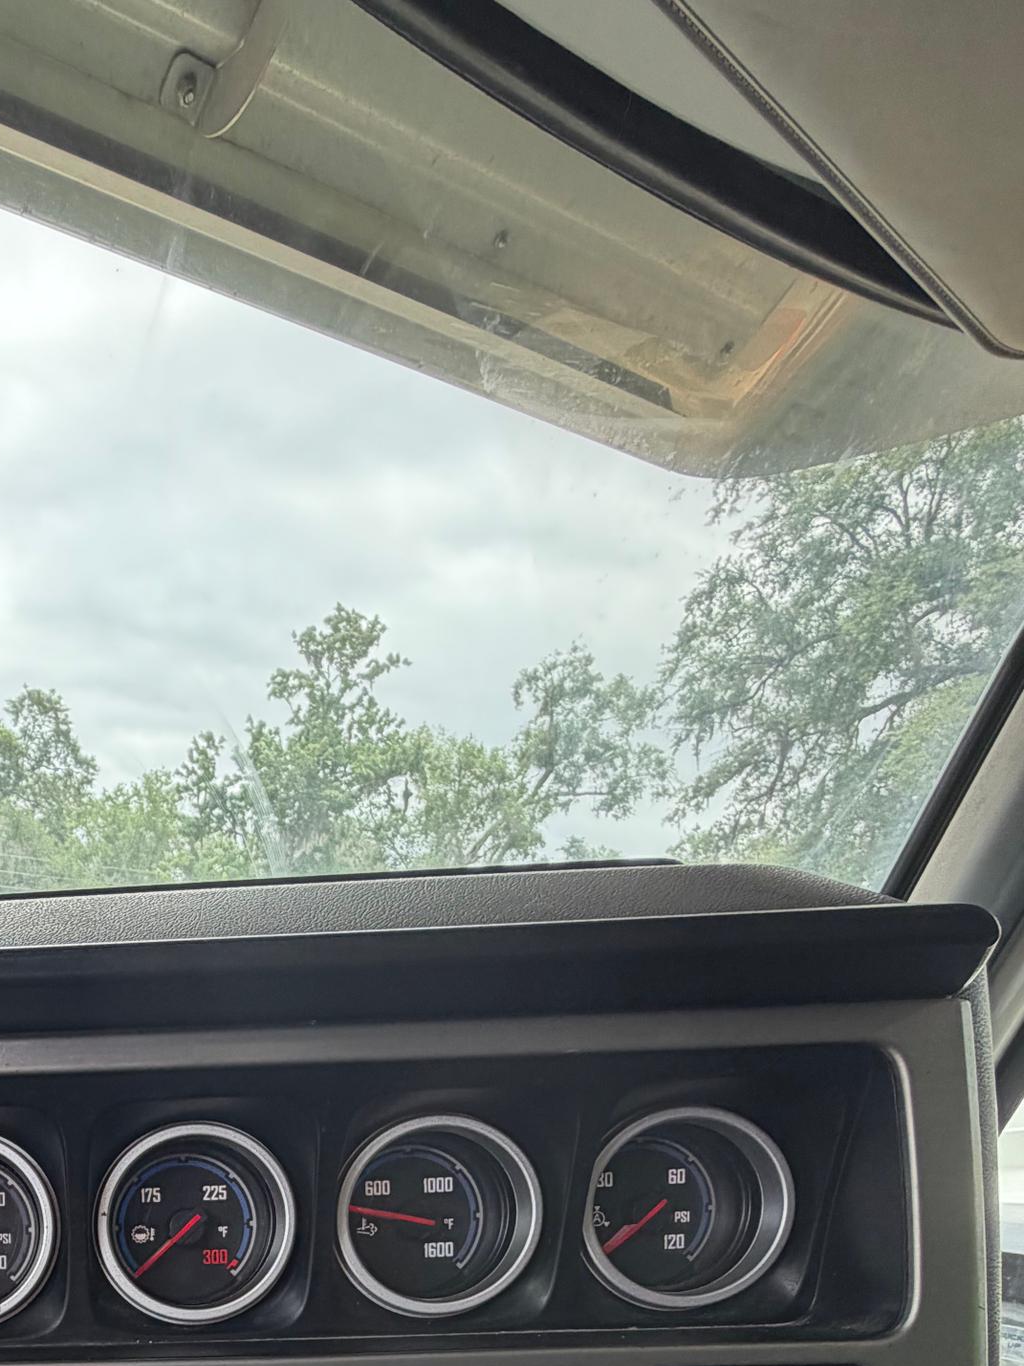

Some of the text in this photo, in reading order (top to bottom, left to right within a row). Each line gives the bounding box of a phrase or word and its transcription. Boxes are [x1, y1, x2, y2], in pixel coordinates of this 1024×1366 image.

[668, 1168, 686, 1184] 60
[202, 1185, 227, 1201] 225
[365, 1180, 390, 1196] 600
[423, 1177, 453, 1193] 1000
[141, 1187, 161, 1203] 175
[674, 1211, 690, 1223] PSI
[664, 1234, 685, 1249] 120
[203, 1249, 228, 1264] 300
[424, 1242, 454, 1258] 1600
